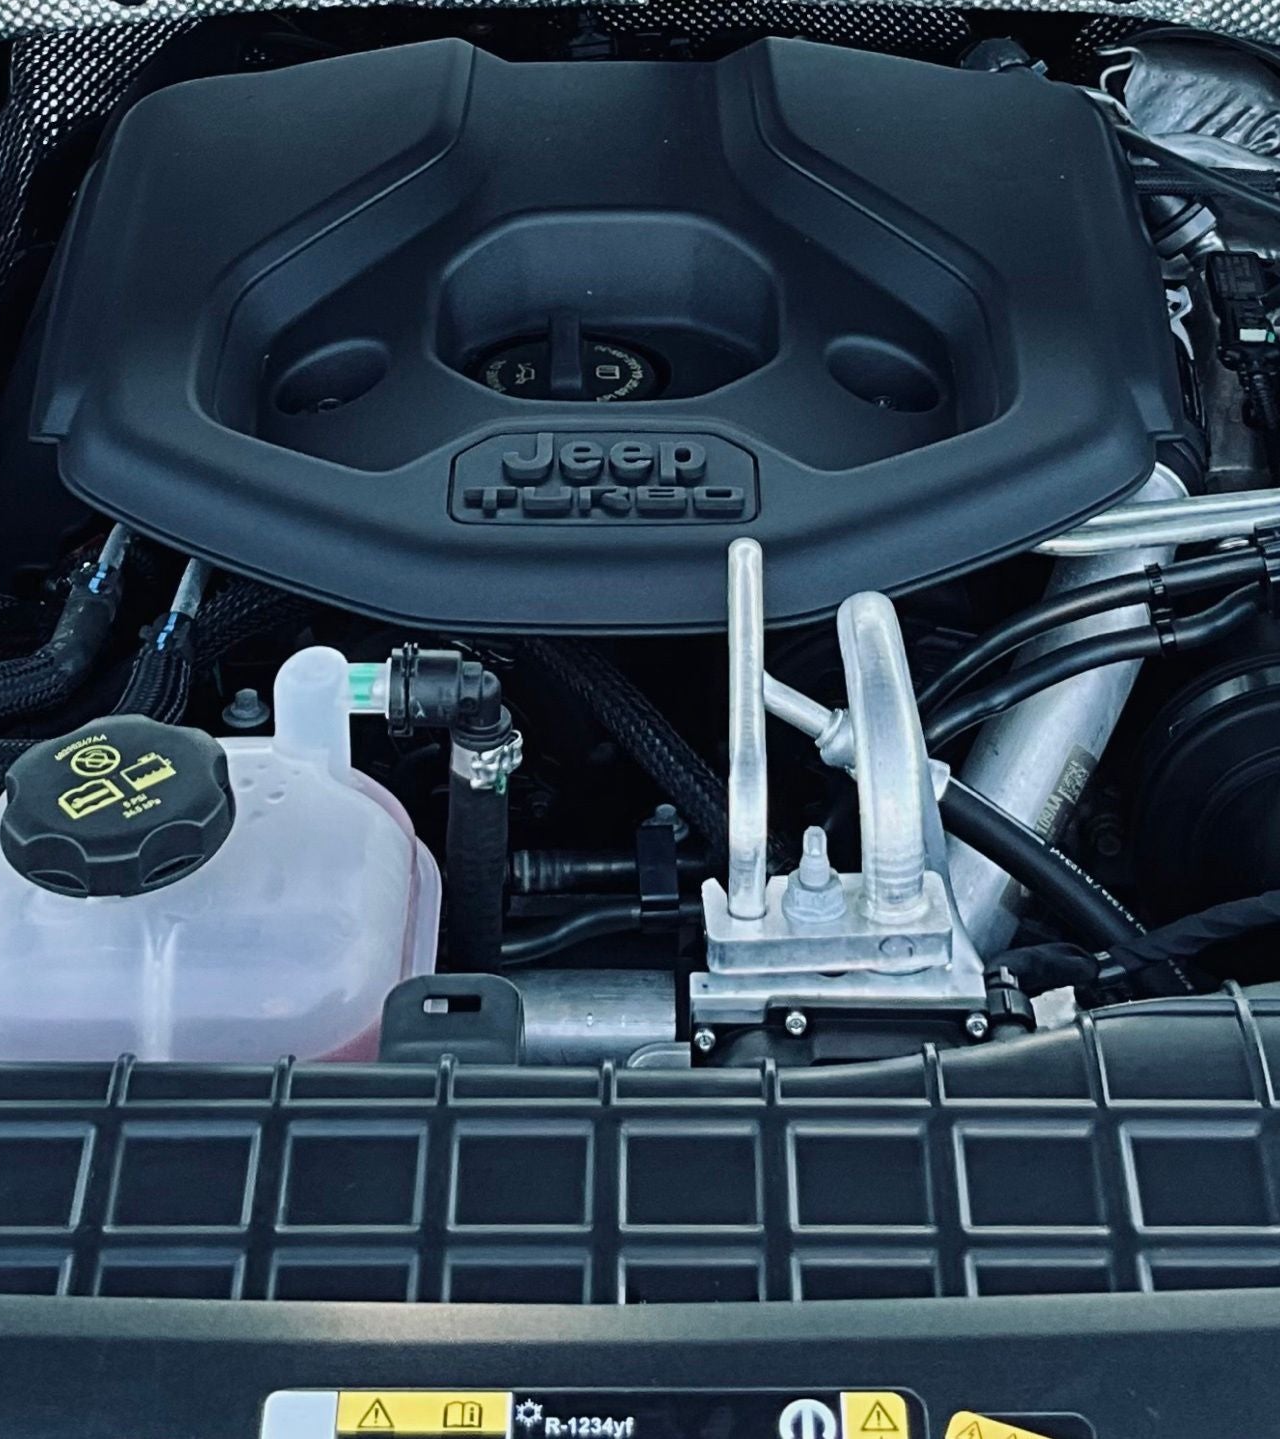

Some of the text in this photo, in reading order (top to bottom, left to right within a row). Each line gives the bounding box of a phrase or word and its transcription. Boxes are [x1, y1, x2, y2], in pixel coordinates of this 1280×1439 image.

[503, 432, 707, 485] Jeep
[464, 485, 746, 519] TURBO
[544, 1416, 635, 1438] R-1234yf
